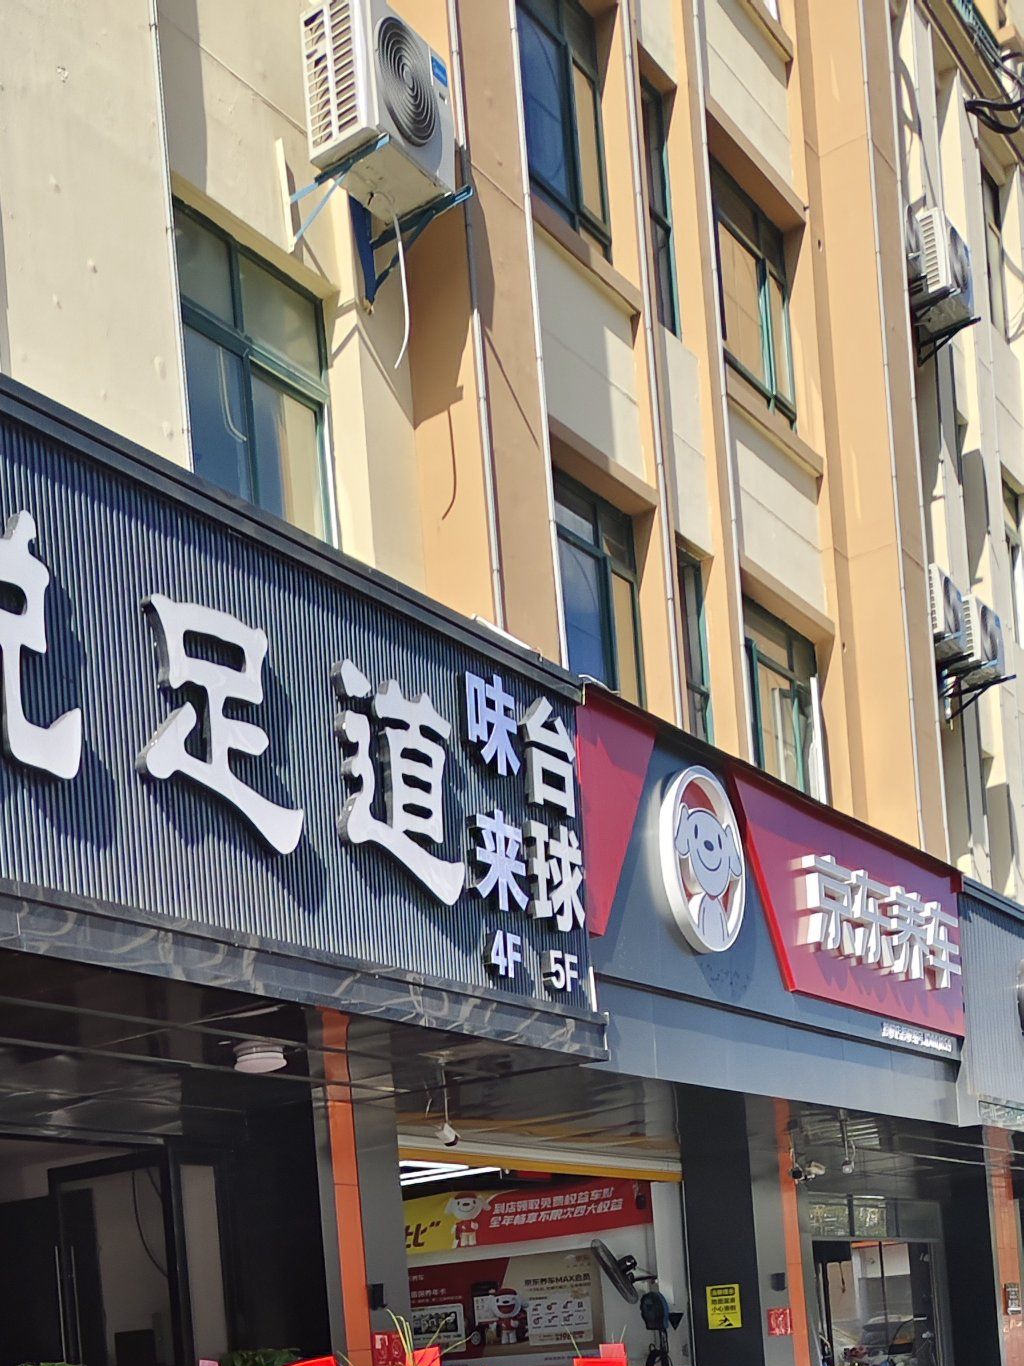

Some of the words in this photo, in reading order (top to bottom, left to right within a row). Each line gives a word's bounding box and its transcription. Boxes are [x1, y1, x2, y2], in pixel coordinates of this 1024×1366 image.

[465, 670, 529, 913] 味来
[520, 697, 585, 932] 台球
[486, 929, 522, 978] 4F
[802, 854, 961, 988] 京东养车
[546, 950, 578, 992] 5F
[489, 1199, 624, 1228] 全年畅享不限次四大权益
